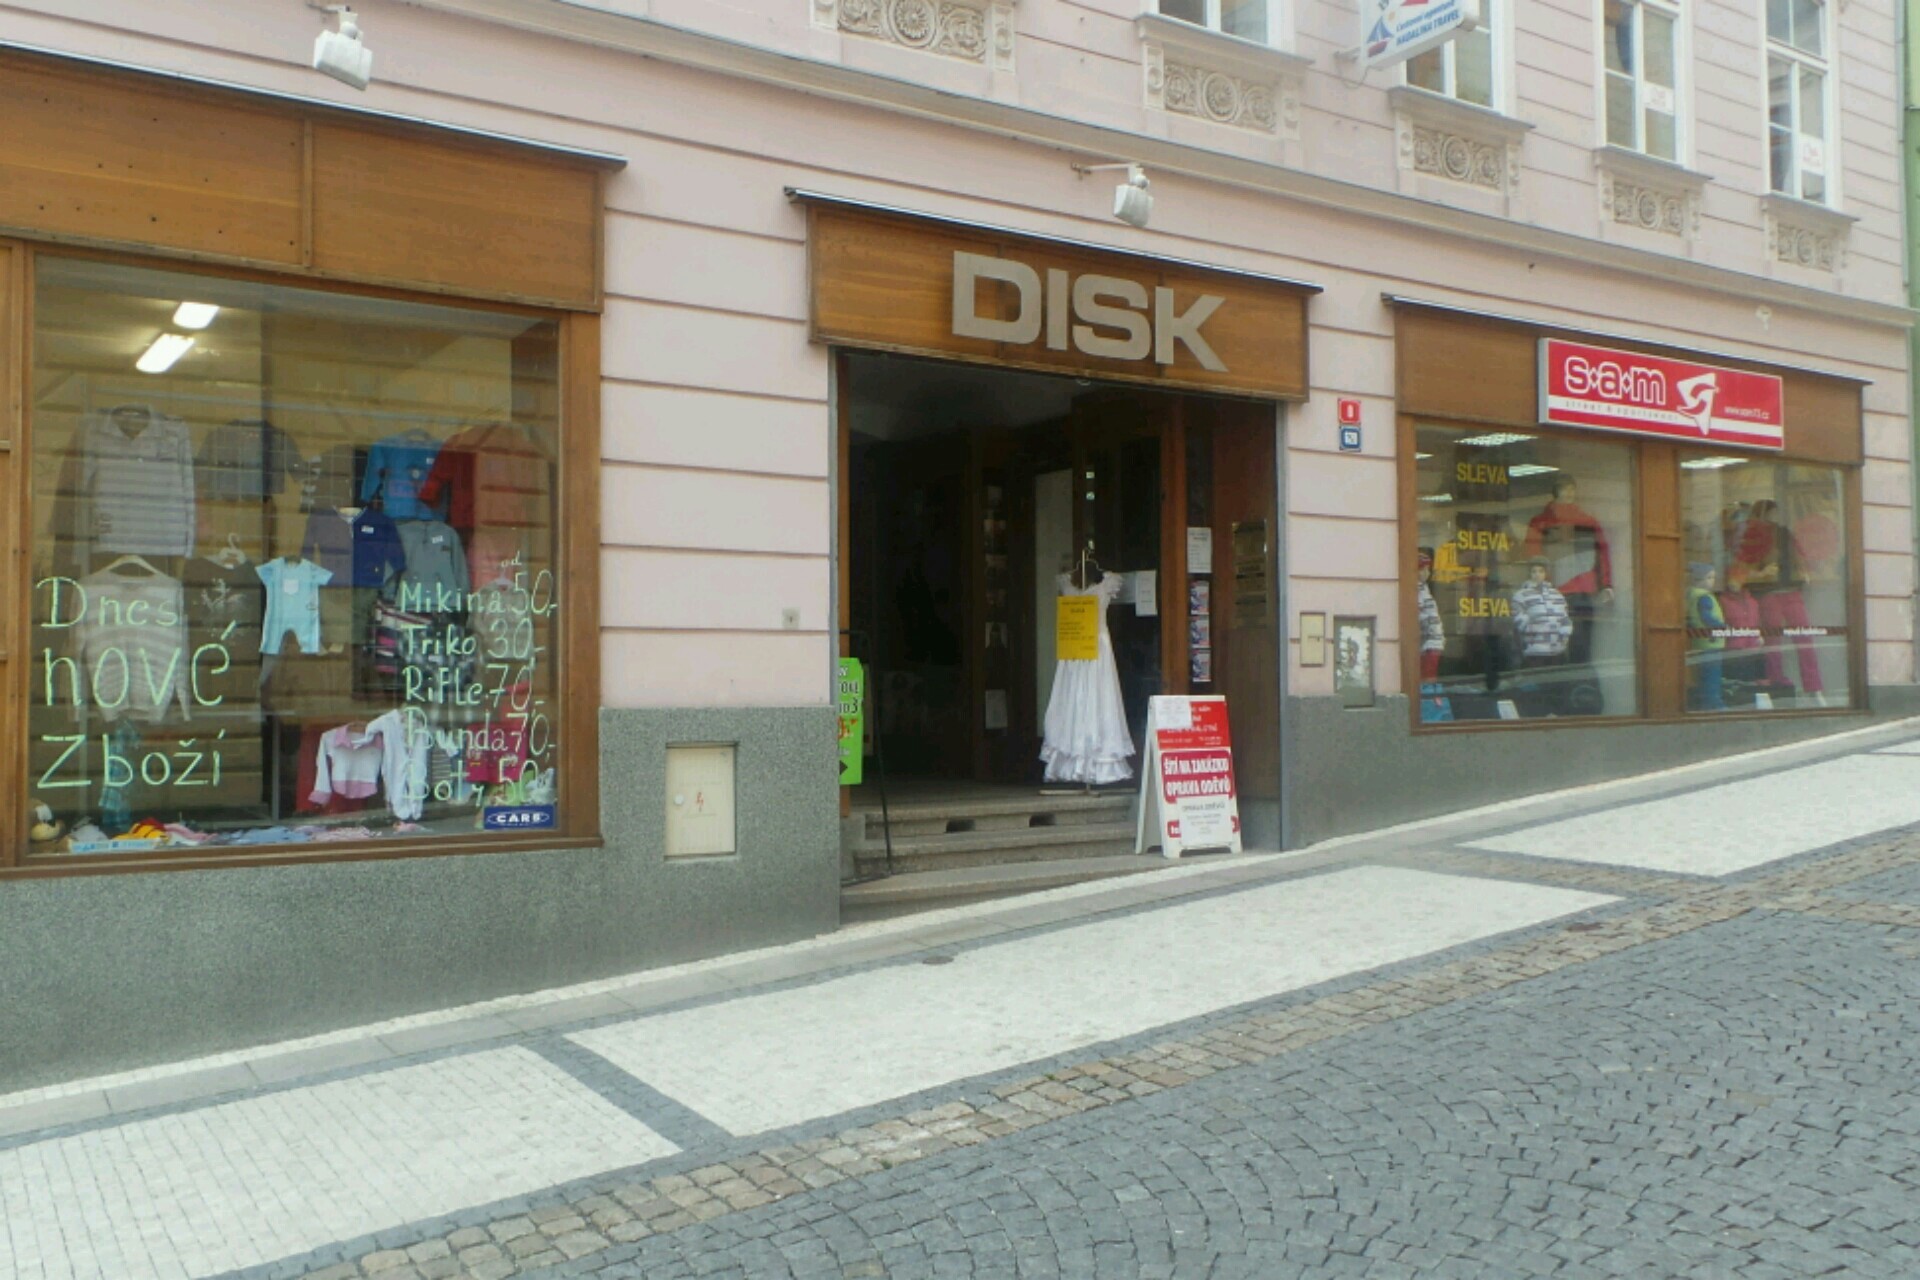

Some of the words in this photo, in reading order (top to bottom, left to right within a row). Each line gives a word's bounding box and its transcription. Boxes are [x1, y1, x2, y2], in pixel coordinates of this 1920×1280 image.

[952, 250, 1229, 372] DISK
[1457, 462, 1508, 485] SLEVA
[1457, 530, 1509, 551] SLEVA
[501, 550, 522, 568] od
[36, 576, 179, 627] Dnes
[401, 579, 504, 613] Mikina
[1458, 597, 1510, 618] SLEVA
[400, 624, 477, 657] Triko
[43, 619, 237, 708] nové
[403, 706, 509, 751] Bunda
[37, 728, 226, 788] Zboží
[1166, 780, 1200, 796] OPRAVA
